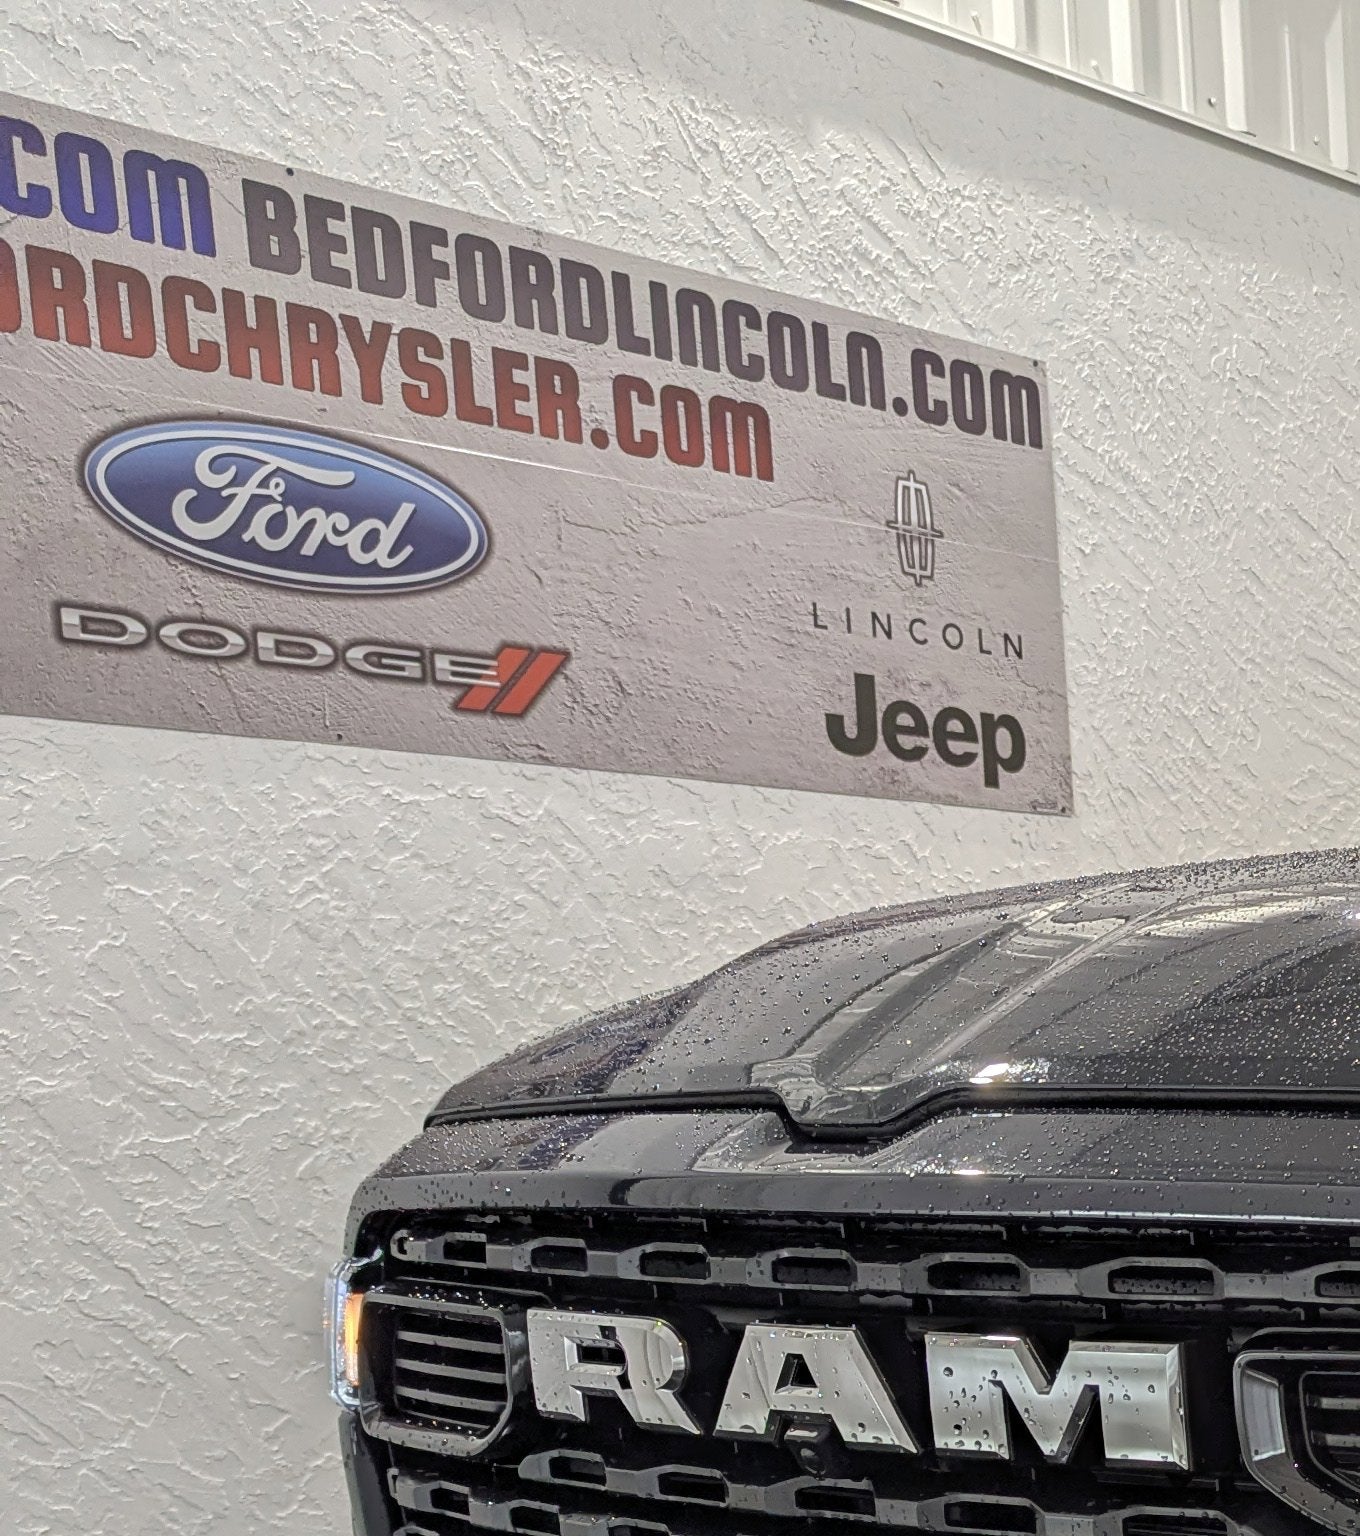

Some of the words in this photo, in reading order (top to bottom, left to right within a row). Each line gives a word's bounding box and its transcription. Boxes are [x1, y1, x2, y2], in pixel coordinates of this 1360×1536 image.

[240, 177, 1044, 451] BEDFORDLINCOLN.COM
[171, 443, 416, 570] Ford
[56, 606, 499, 687] DODGE
[810, 601, 1025, 661] LINCOLN
[823, 672, 1027, 790] Jeep
[525, 1307, 1194, 1472] RAM
